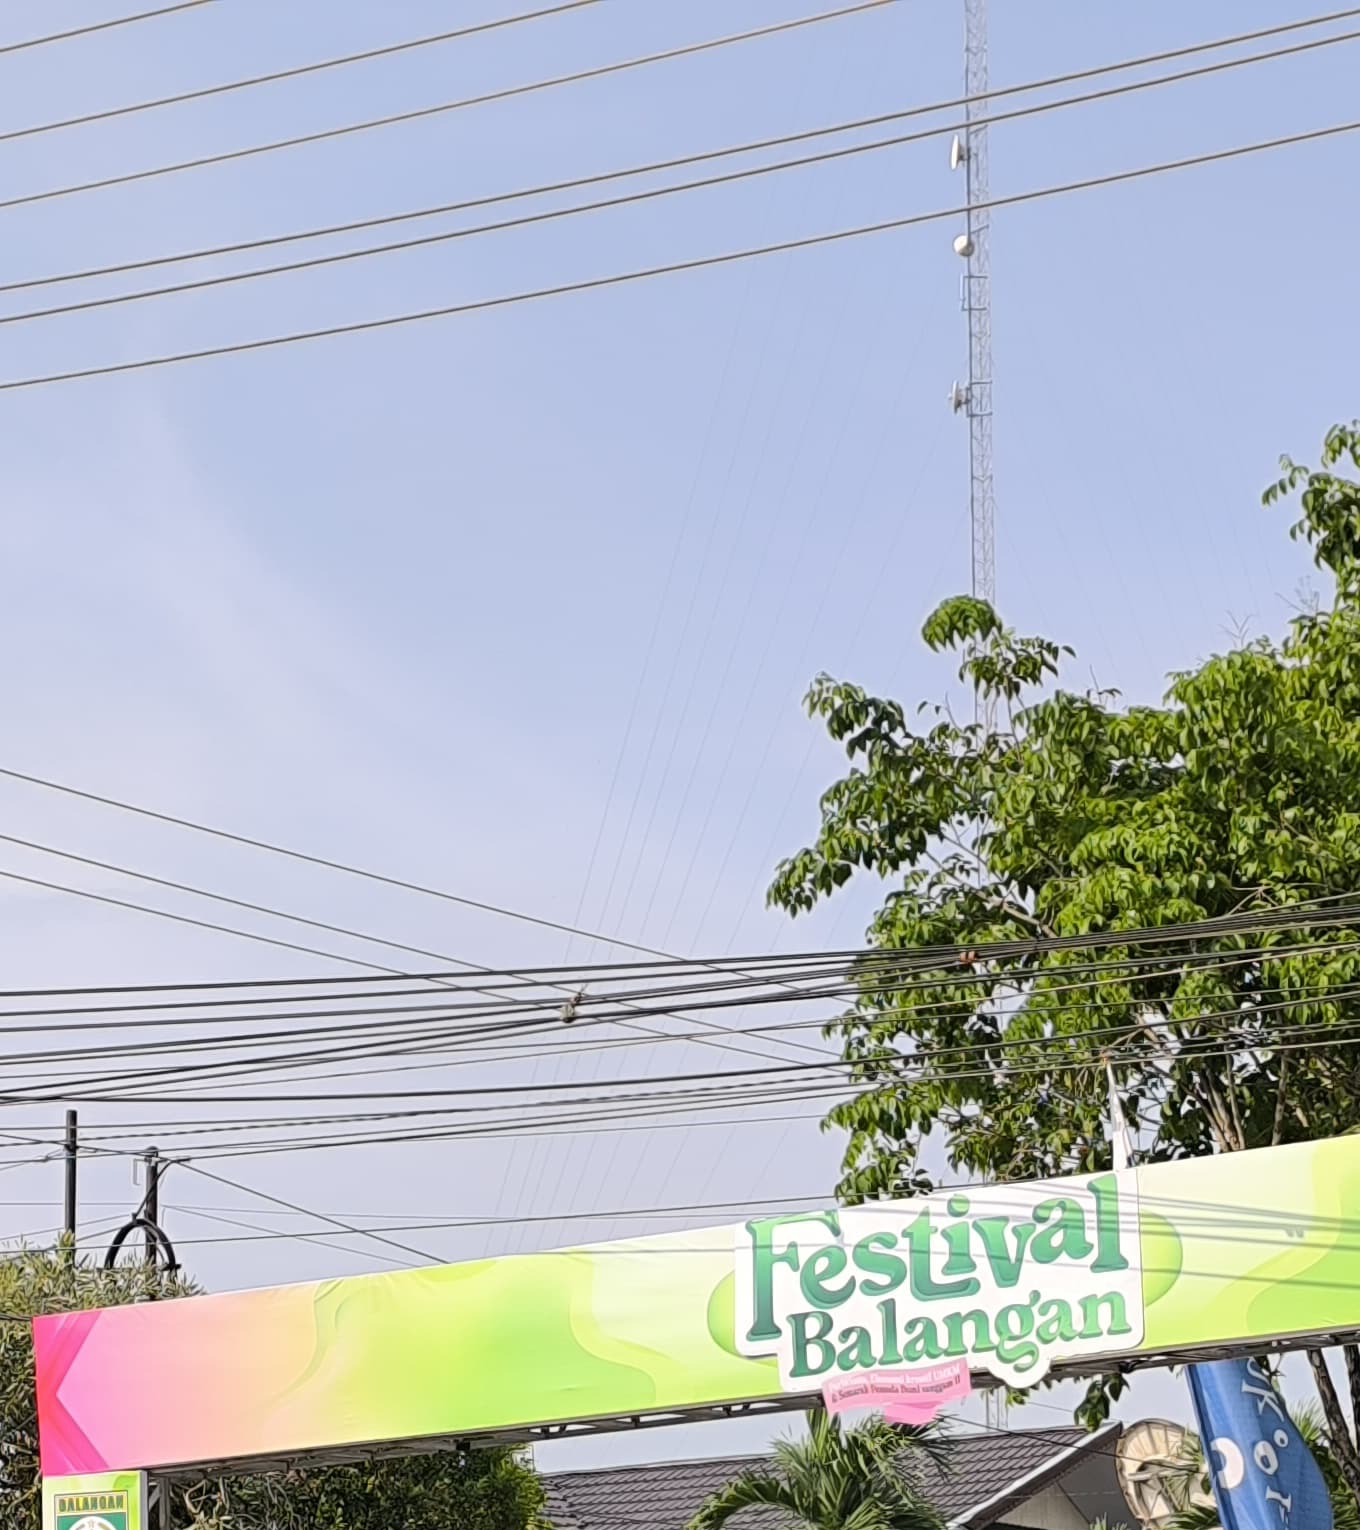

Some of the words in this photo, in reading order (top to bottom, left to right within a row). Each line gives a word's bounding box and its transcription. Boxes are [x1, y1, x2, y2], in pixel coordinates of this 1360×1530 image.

[745, 1173, 1129, 1342] Festival
[786, 1289, 1132, 1378] Balangan
[58, 1494, 124, 1513] BALANGAN
